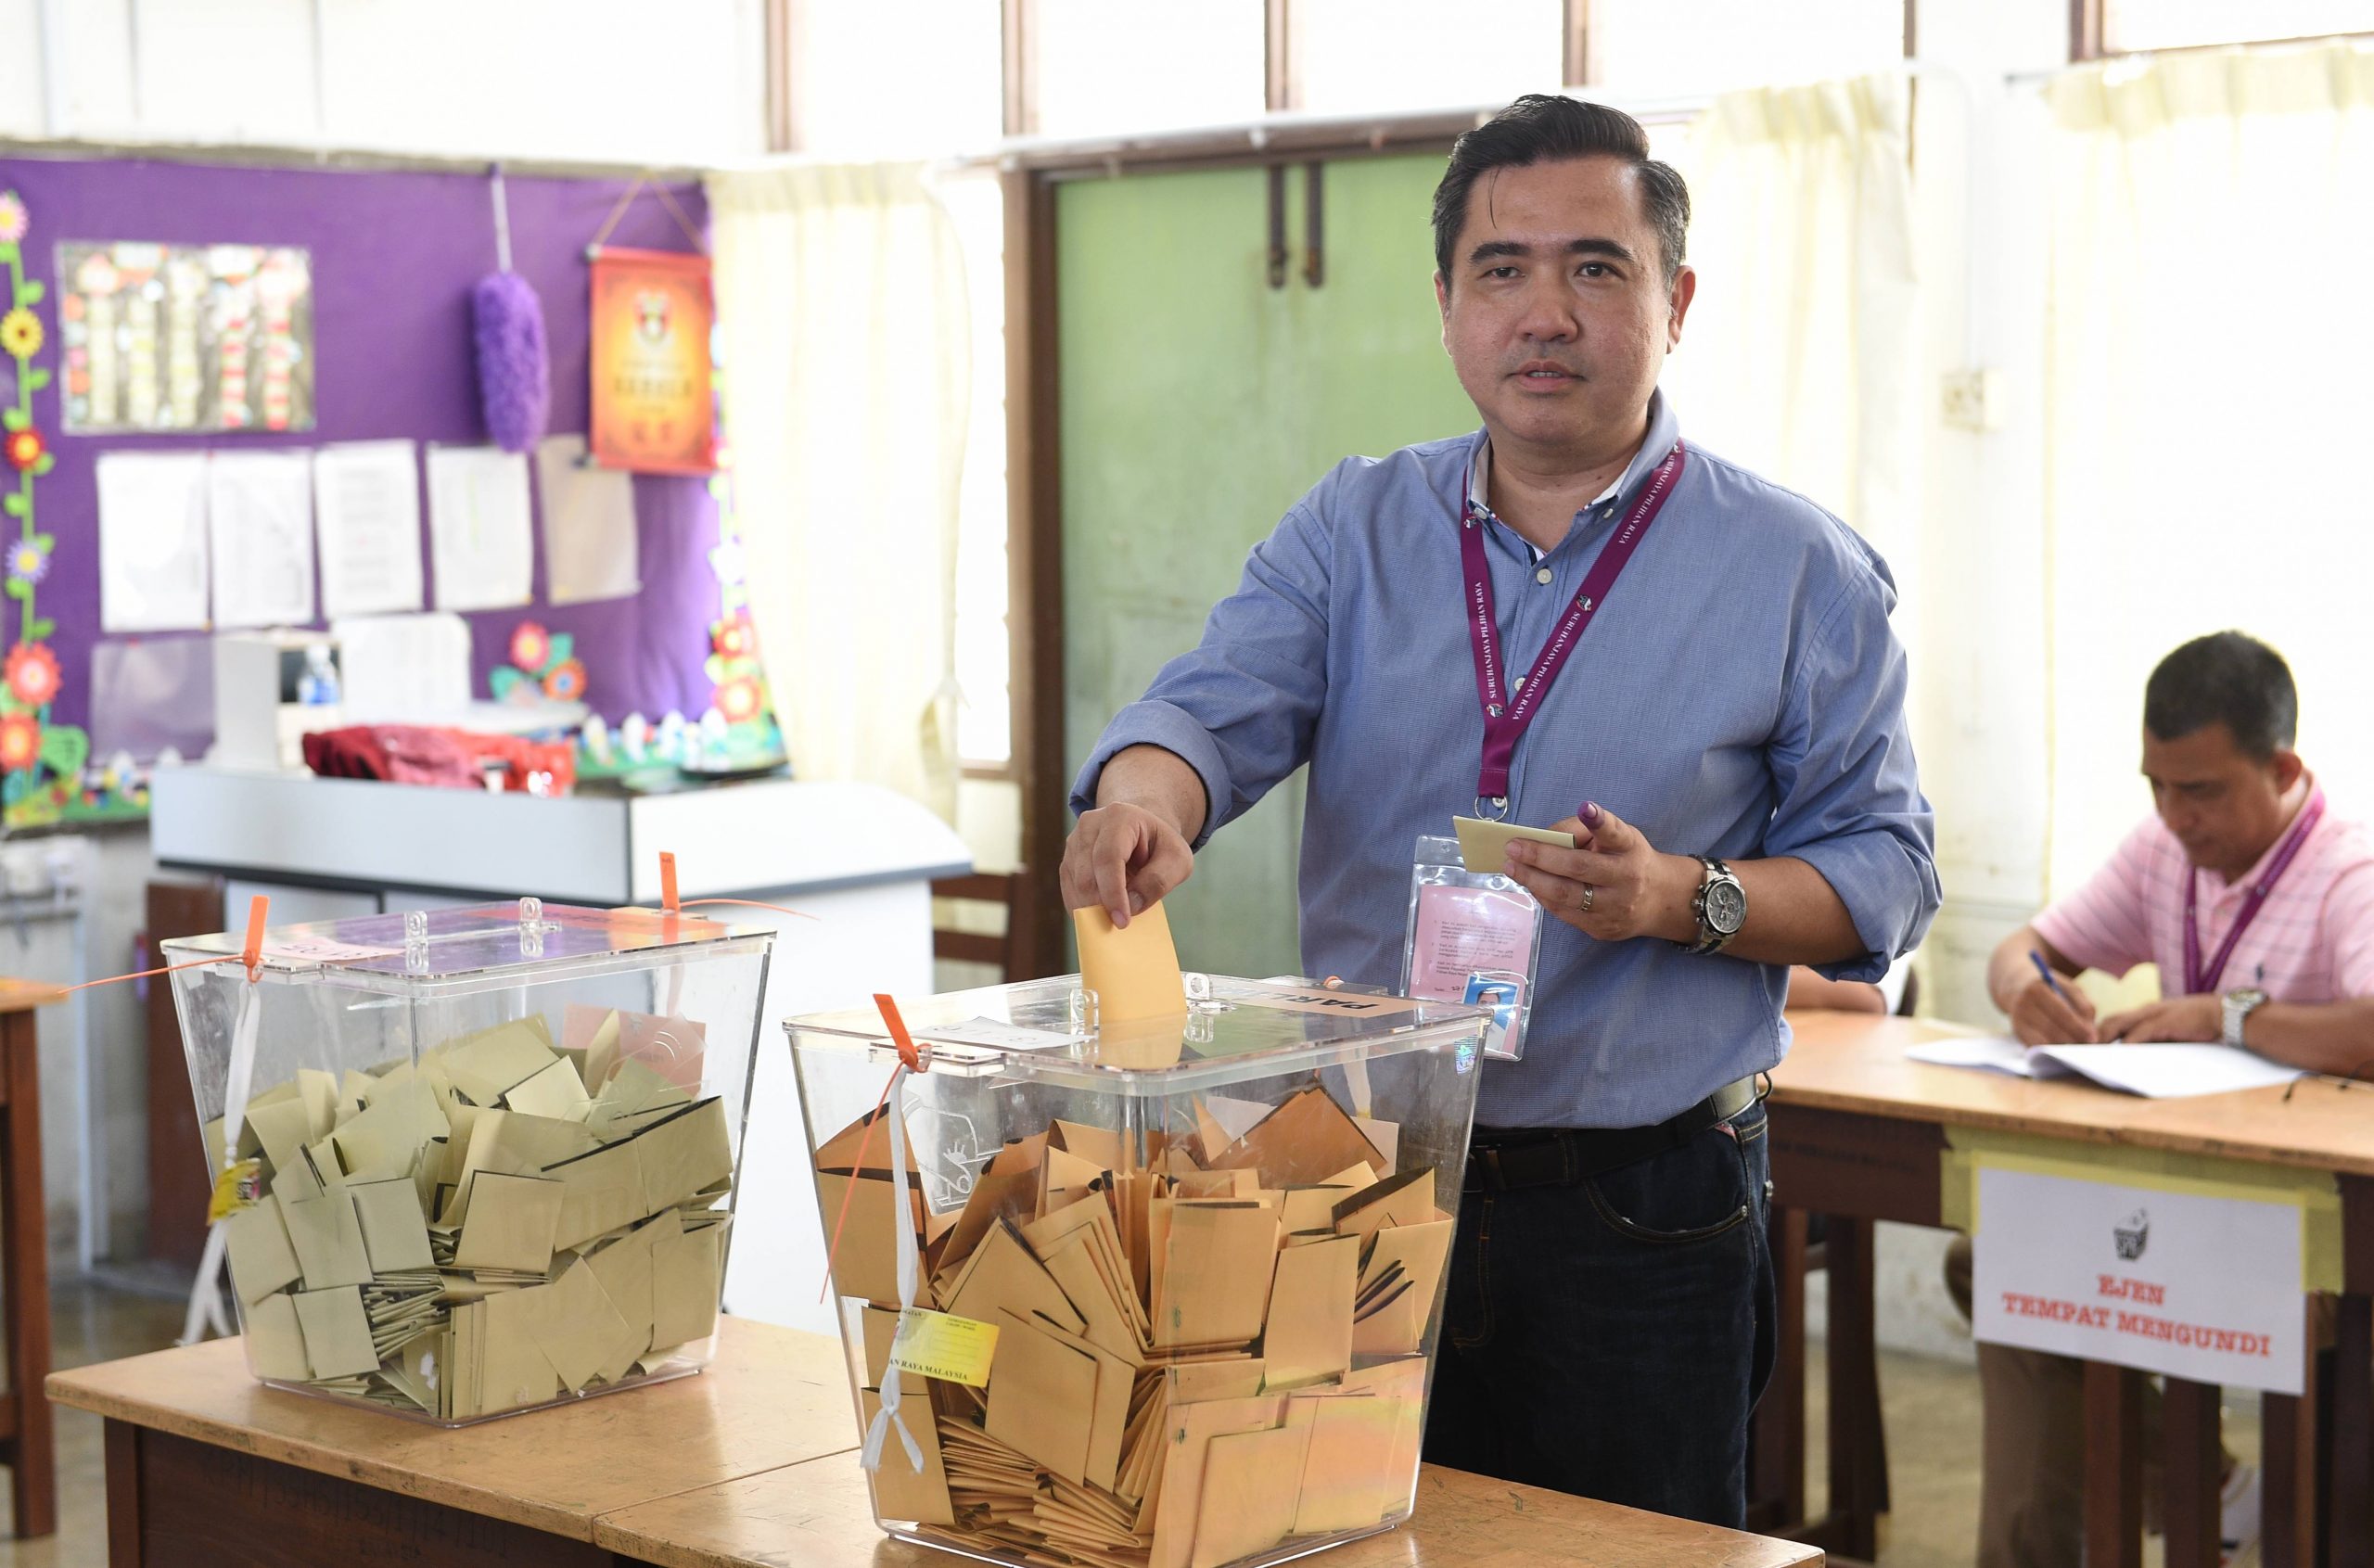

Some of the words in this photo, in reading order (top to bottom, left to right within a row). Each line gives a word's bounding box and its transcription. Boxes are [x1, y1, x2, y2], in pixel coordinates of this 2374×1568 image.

[1632, 493, 1655, 526] PILIHAN
[1618, 524, 1636, 544] RAYA
[1474, 581, 1484, 603] RAYA
[1477, 605, 1488, 638] PILIHAN
[1543, 611, 1581, 666] SURUHANJAYA
[1484, 639, 1497, 699] SURUHANJAYA
[1525, 666, 1548, 698] PILIHAN
[1512, 698, 1528, 720] RAYA
[2097, 1274, 2165, 1305] EJEN
[2002, 1293, 2111, 1329] TEMPAT
[2117, 1310, 2271, 1357] MENGUNDI
[901, 1359, 923, 1371] RAYA
[925, 1366, 967, 1381] MALAYSIA
